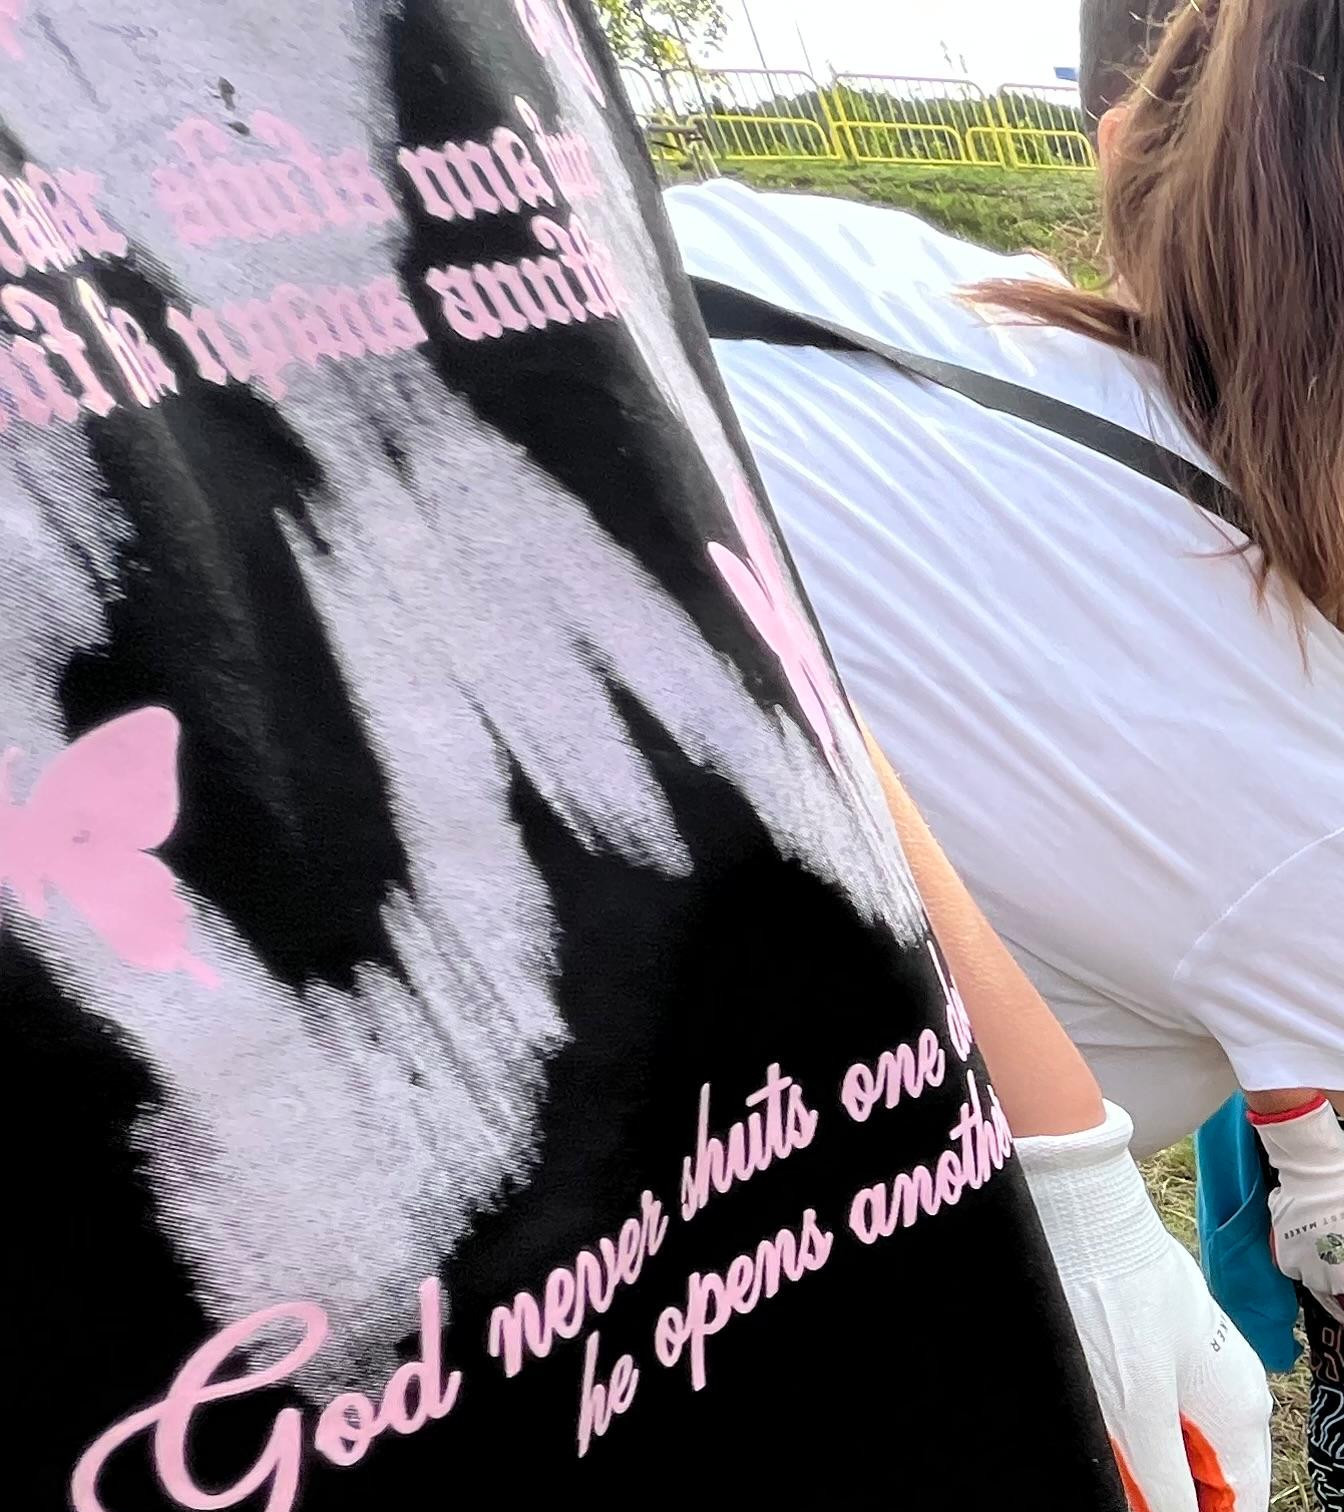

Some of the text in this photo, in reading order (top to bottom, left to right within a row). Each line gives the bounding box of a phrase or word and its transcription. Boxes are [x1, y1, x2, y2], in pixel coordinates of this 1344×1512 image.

[487, 1189, 669, 1378] never
[680, 1062, 818, 1222] shuts
[842, 1029, 945, 1124] one
[577, 1330, 638, 1459] he
[655, 1209, 831, 1392] opens
